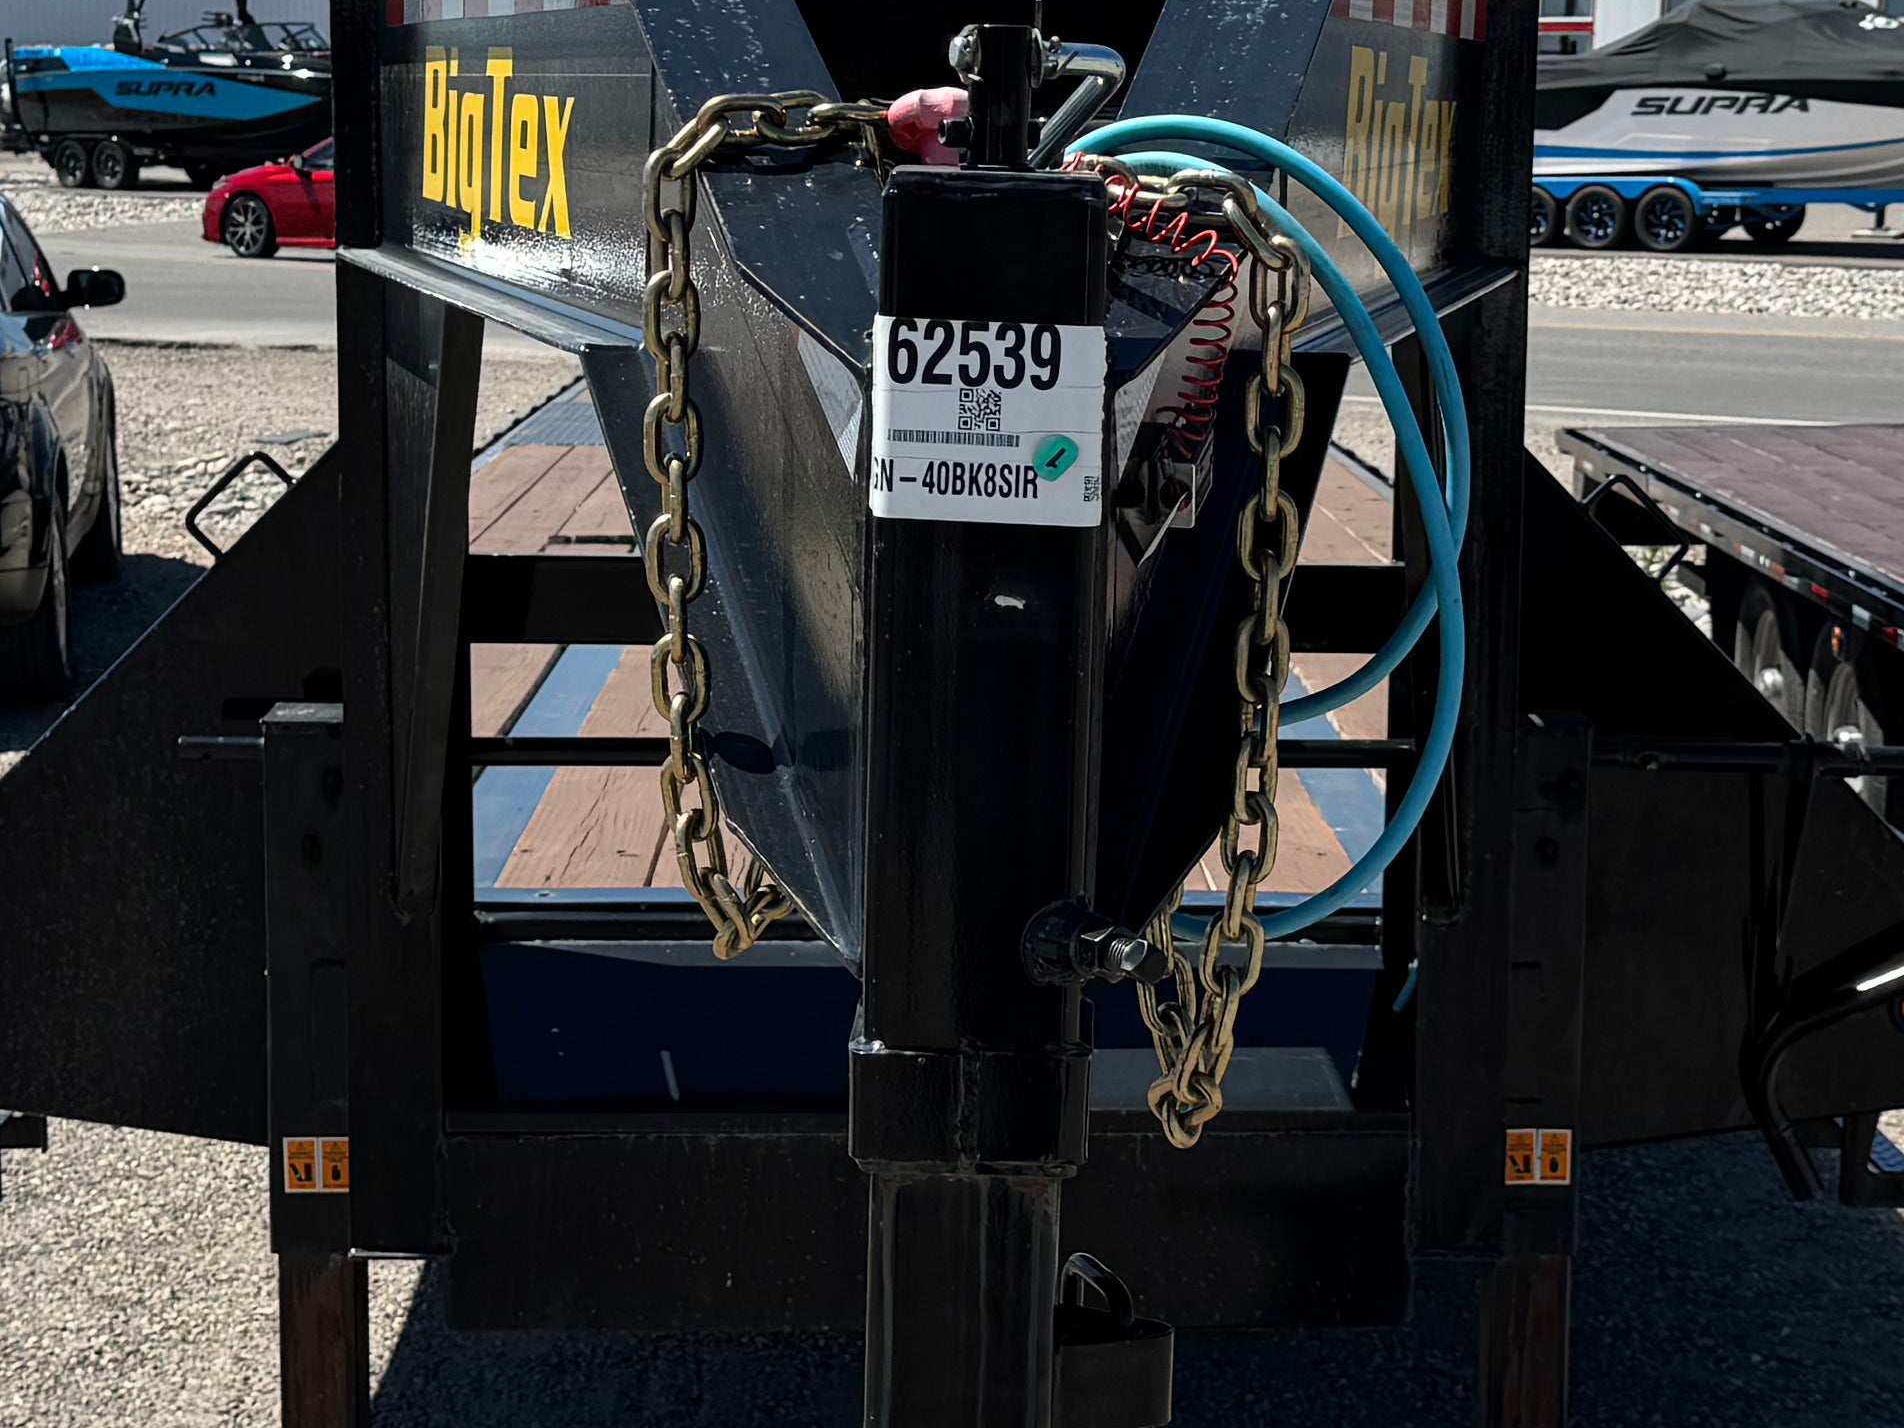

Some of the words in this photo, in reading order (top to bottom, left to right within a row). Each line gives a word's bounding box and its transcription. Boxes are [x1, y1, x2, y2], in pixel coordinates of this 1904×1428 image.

[114, 79, 217, 97] SUPRA
[1630, 95, 1811, 117] SUPRA
[887, 318, 1063, 391] 62539
